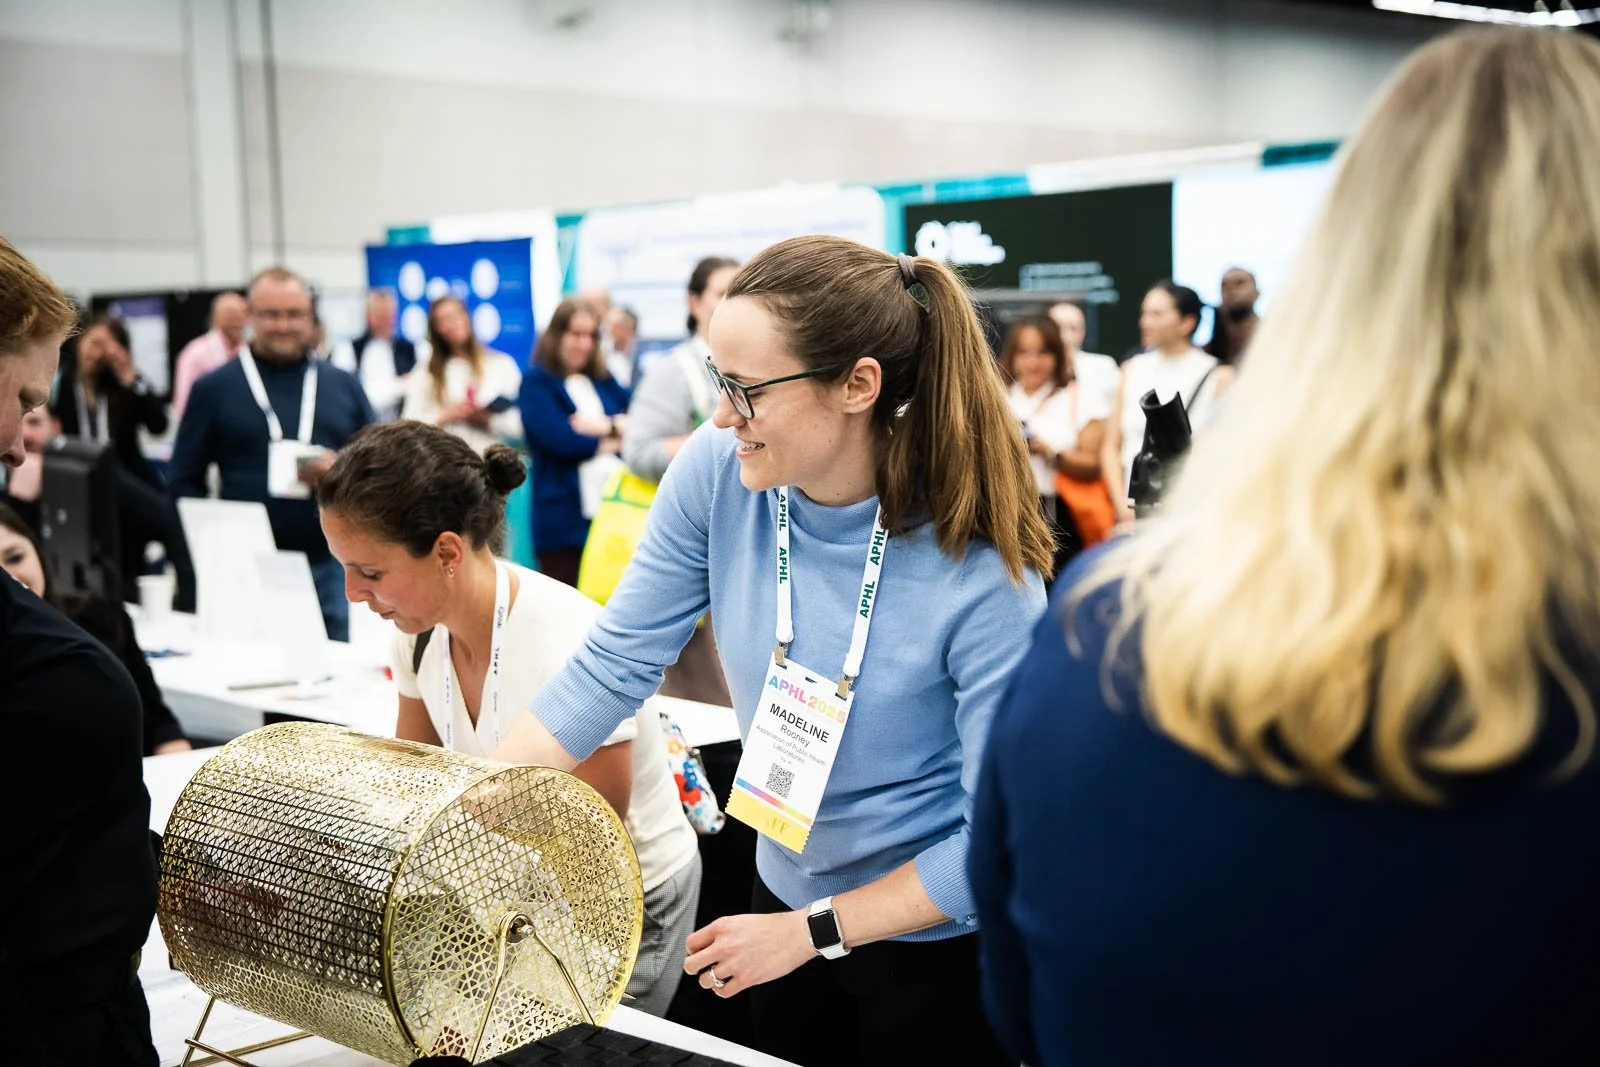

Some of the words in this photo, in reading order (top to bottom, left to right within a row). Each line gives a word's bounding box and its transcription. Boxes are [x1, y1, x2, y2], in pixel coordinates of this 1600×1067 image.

[779, 494, 788, 531] APHL
[779, 546, 788, 584] APHL
[870, 529, 886, 566] APHL
[859, 581, 876, 618] APHL
[768, 675, 845, 724] APHL2025
[769, 703, 830, 743] MADELINE
[780, 724, 810, 748] Rooney
[756, 724, 785, 743] Association
[792, 743, 809, 756] Public
[808, 754, 826, 766] Health
